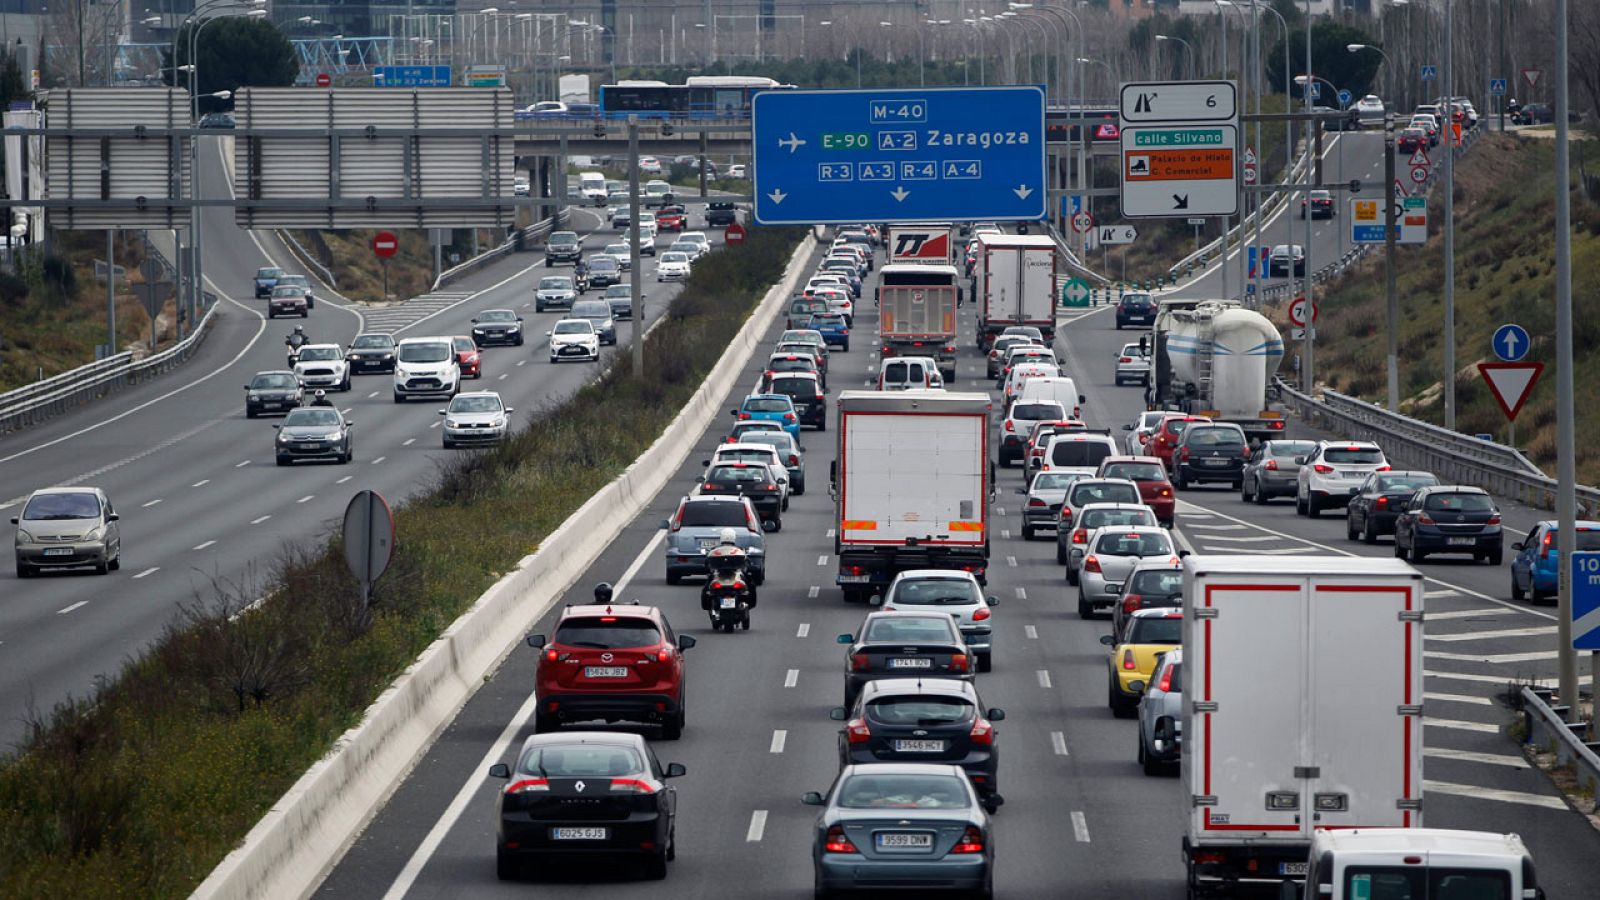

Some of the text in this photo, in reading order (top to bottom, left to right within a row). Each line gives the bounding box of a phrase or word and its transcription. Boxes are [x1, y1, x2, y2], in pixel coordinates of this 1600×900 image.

[1206, 95, 1216, 107] 6
[874, 105, 922, 118] M-40
[823, 130, 1030, 148] E-90 A-2 Zaragoza
[1137, 132, 1221, 143] calle Silvano
[822, 163, 977, 178] R-3 A-3 R-4 A-4
[1125, 230, 1133, 239] 6
[895, 234, 929, 254] TT
